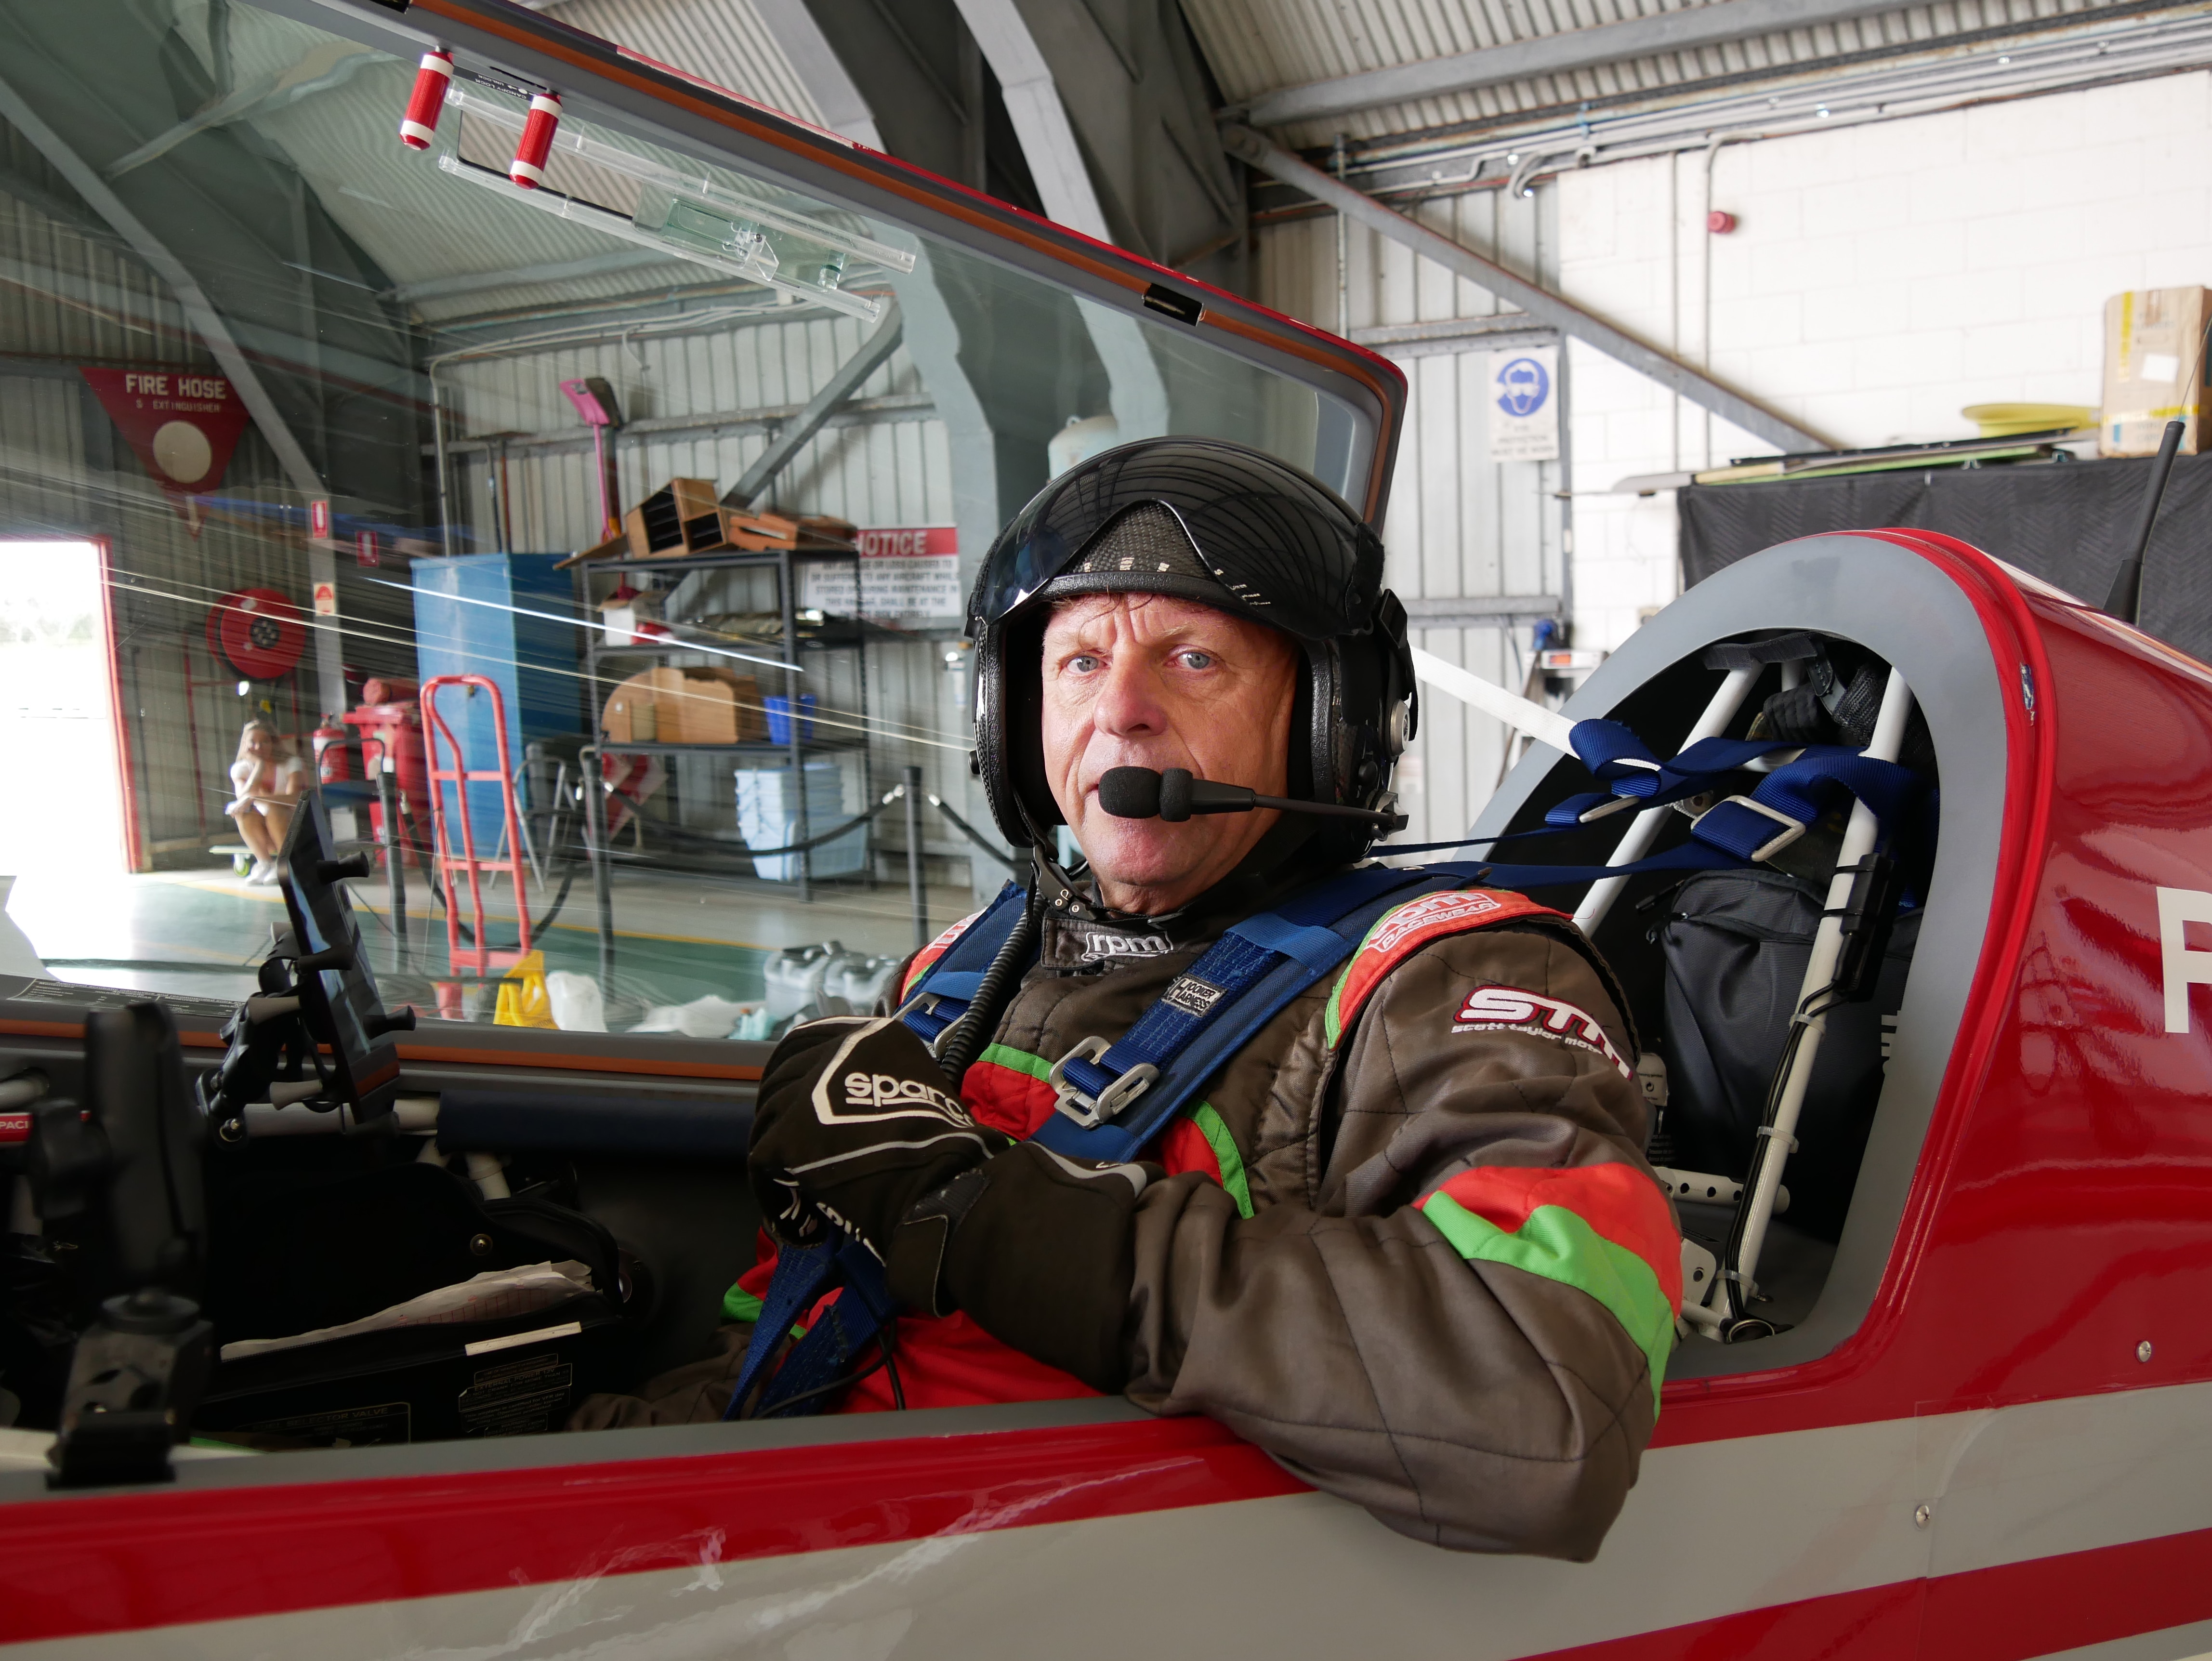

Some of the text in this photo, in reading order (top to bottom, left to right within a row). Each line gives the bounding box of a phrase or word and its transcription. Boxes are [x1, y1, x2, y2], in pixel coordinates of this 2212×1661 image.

[475, 79, 526, 99] CANOPY LOCK
[478, 75, 504, 86] UNLOCK
[126, 374, 226, 399] FIRE HOSE
[1371, 894, 1481, 940] rpm
[1382, 903, 1494, 949] RACEWEAR
[1093, 935, 1167, 954] rpm
[1451, 1022, 1505, 1033] scott
[1508, 1023, 1562, 1040] taylor
[474, 1378, 512, 1391] EXTERNAL
[514, 1371, 540, 1382] POWER
[543, 1396, 562, 1405] known
[286, 1413, 348, 1427] SELECTOR
[353, 1407, 389, 1418] VALVE
